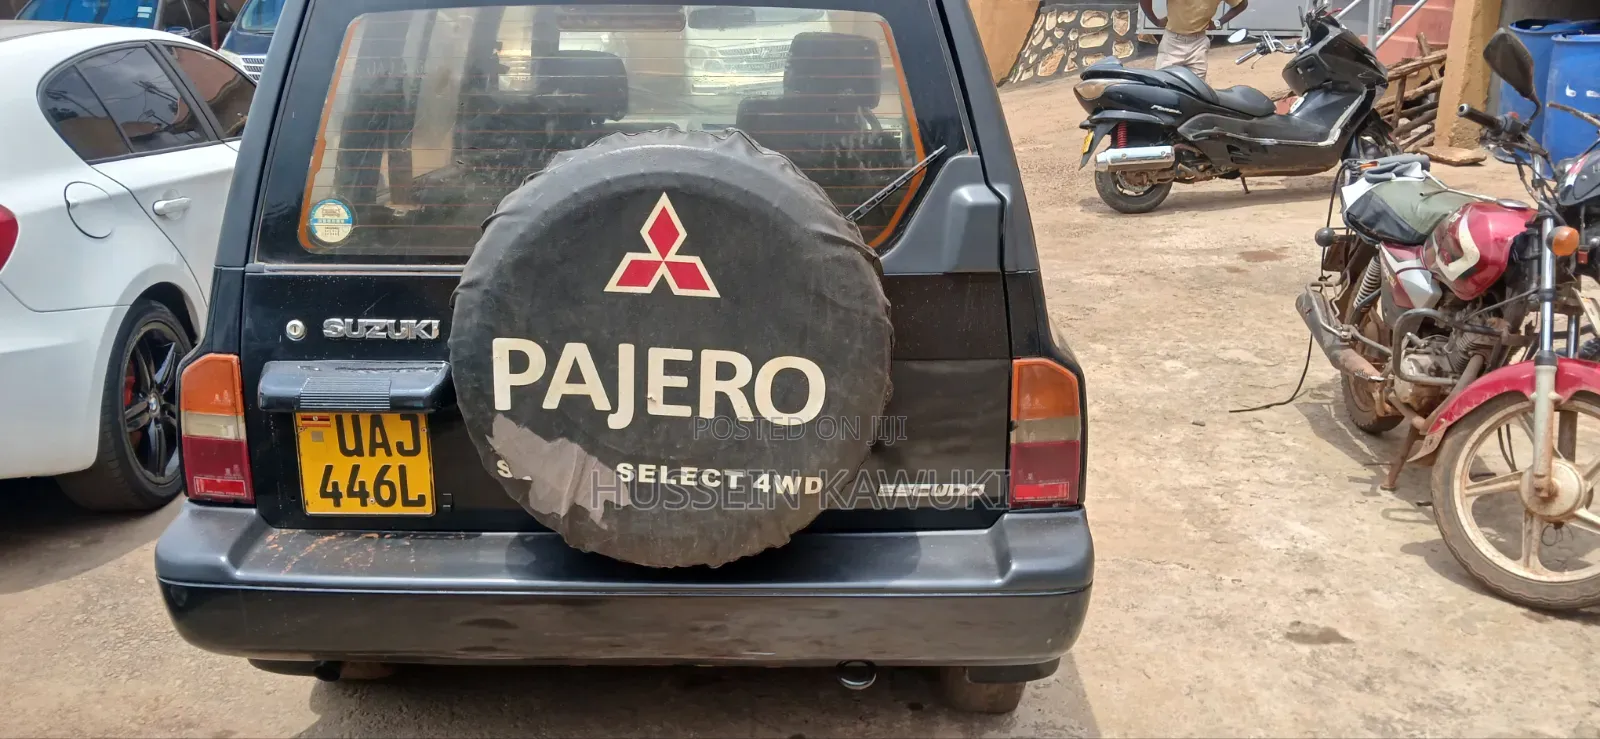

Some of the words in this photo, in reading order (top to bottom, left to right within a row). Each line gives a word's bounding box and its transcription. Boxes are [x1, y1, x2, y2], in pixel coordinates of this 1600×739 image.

[322, 317, 441, 340] SUZUKI
[492, 337, 827, 430] PAJERO
[334, 413, 422, 457] UAJ
[319, 463, 427, 508] 446L
[616, 462, 744, 490] SELECT
[752, 473, 824, 495] 4WD
[877, 483, 986, 497] ESCUDO
